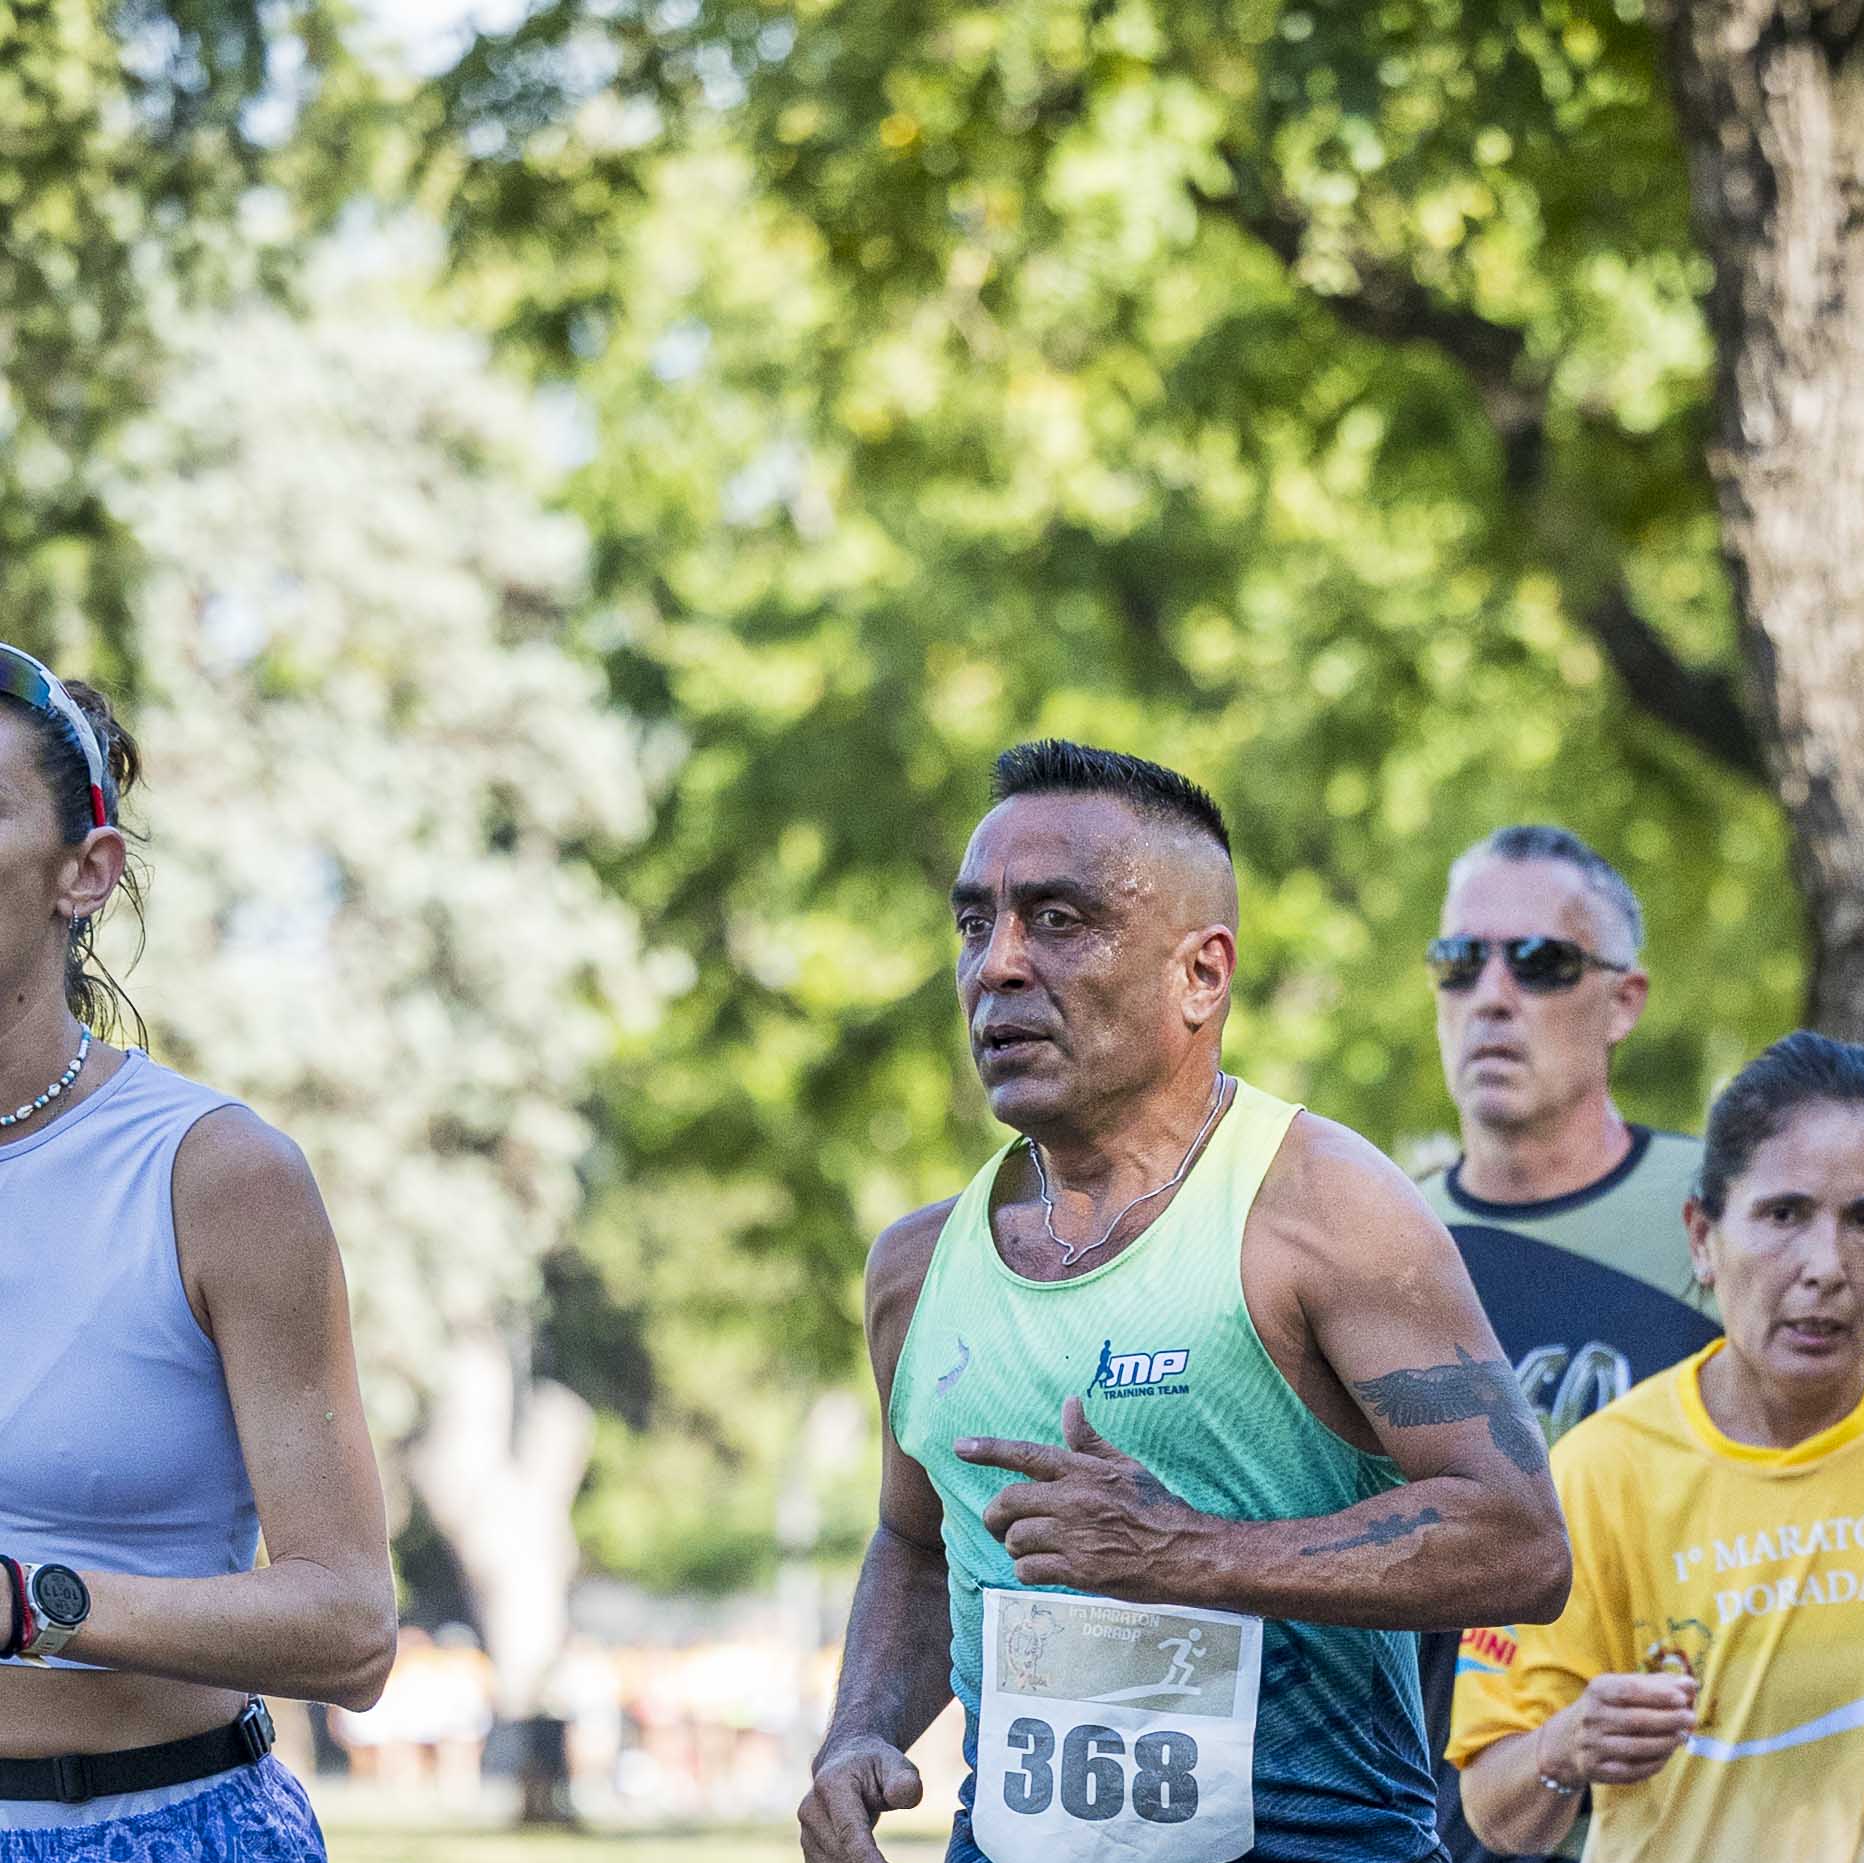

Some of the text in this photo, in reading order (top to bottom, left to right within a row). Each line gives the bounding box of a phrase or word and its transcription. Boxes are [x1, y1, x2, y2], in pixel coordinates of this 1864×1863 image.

[1104, 1349, 1190, 1388] MP
[1103, 1385, 1190, 1401] TRAINING TEAM
[1003, 1717, 1199, 1824] 368
